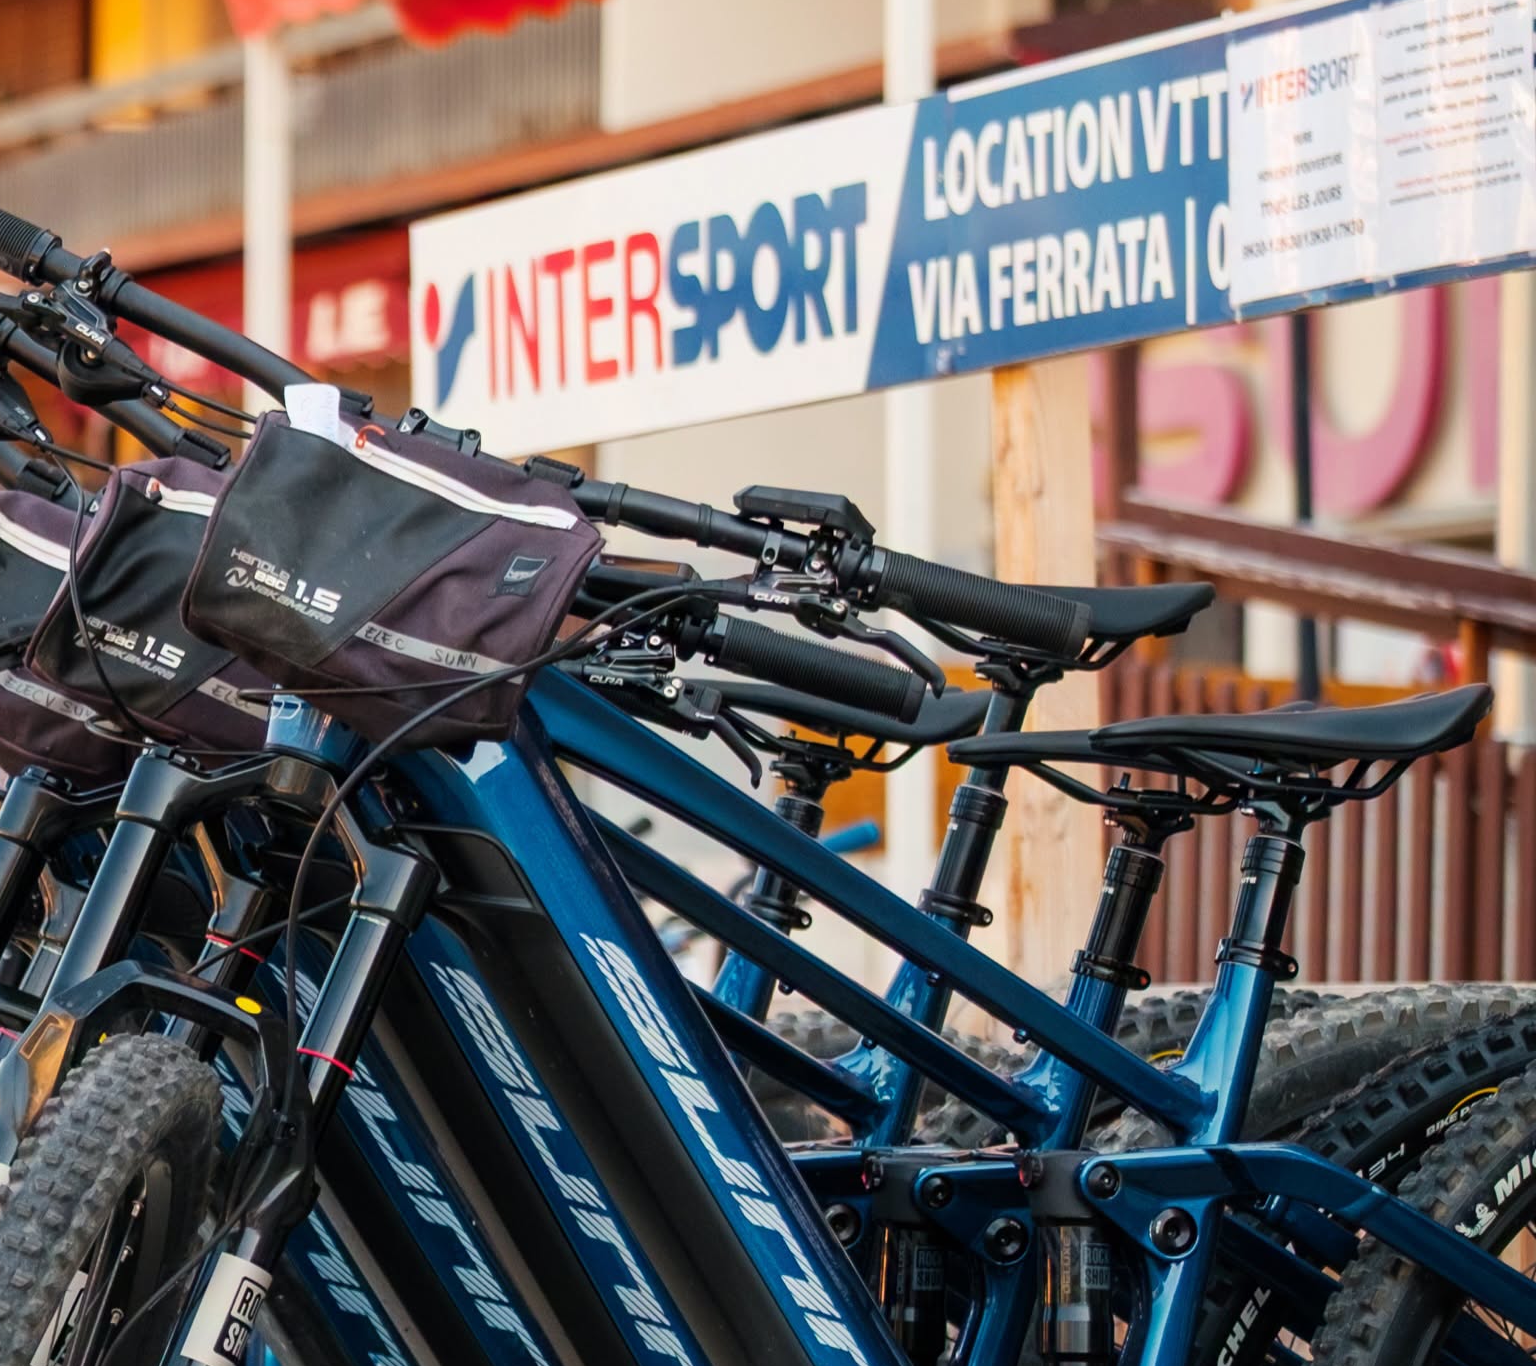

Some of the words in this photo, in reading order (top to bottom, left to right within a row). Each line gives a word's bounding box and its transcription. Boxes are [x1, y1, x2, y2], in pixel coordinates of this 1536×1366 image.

[922, 91, 1133, 222] LOCATION
[1137, 69, 1230, 174] VTT
[486, 181, 868, 403] INTERSPORT
[907, 249, 984, 345] VIA
[988, 211, 1176, 332] FERRATA
[142, 635, 186, 669] 1.5
[295, 578, 342, 615] 1.5
